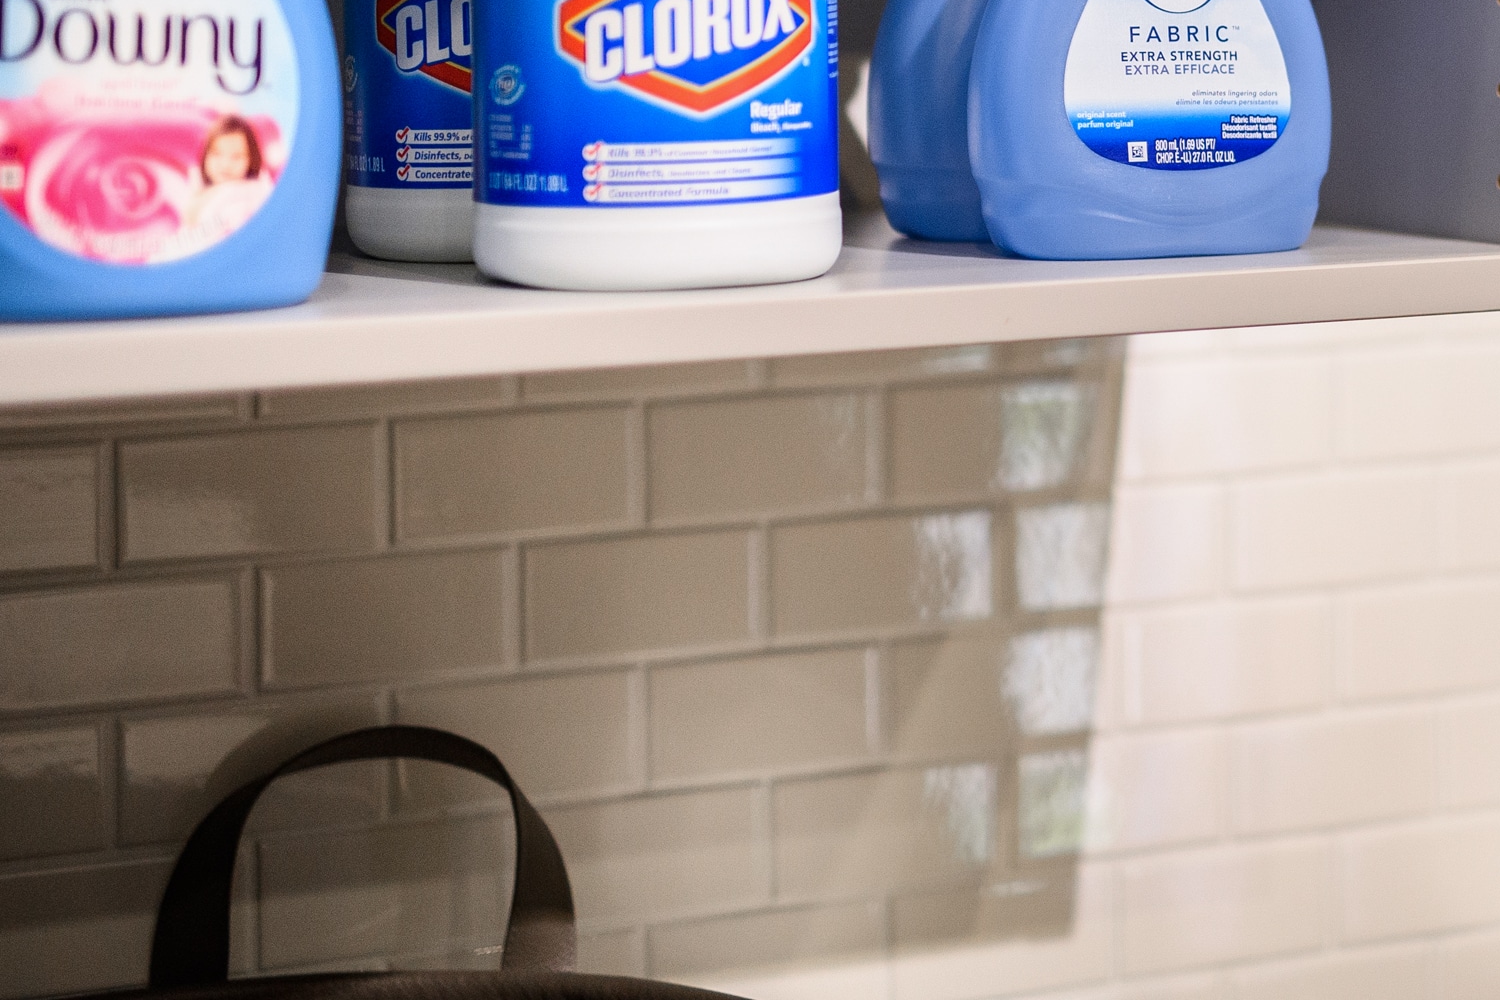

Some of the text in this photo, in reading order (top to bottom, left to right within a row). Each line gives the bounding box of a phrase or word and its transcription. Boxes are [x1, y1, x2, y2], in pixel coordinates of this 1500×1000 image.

[1129, 25, 1229, 43] FABRIC
[1120, 50, 1238, 62] EXTRA STRENGTH
[1125, 63, 1236, 76] EXTRA EFFICACE
[1191, 89, 1278, 98] eliminates lingering odors
[1238, 98, 1279, 107] persistantes
[749, 97, 804, 121] Regular
[1076, 110, 1105, 120] original
[1230, 115, 1249, 124] Fabric
[1077, 119, 1134, 130] parfum original
[413, 132, 432, 142] Kills
[433, 132, 460, 141] 99.9%
[1155, 139, 1168, 151] 800
[1168, 139, 1179, 151] mL
[1195, 138, 1205, 151] US
[414, 150, 461, 161] Disinfects,
